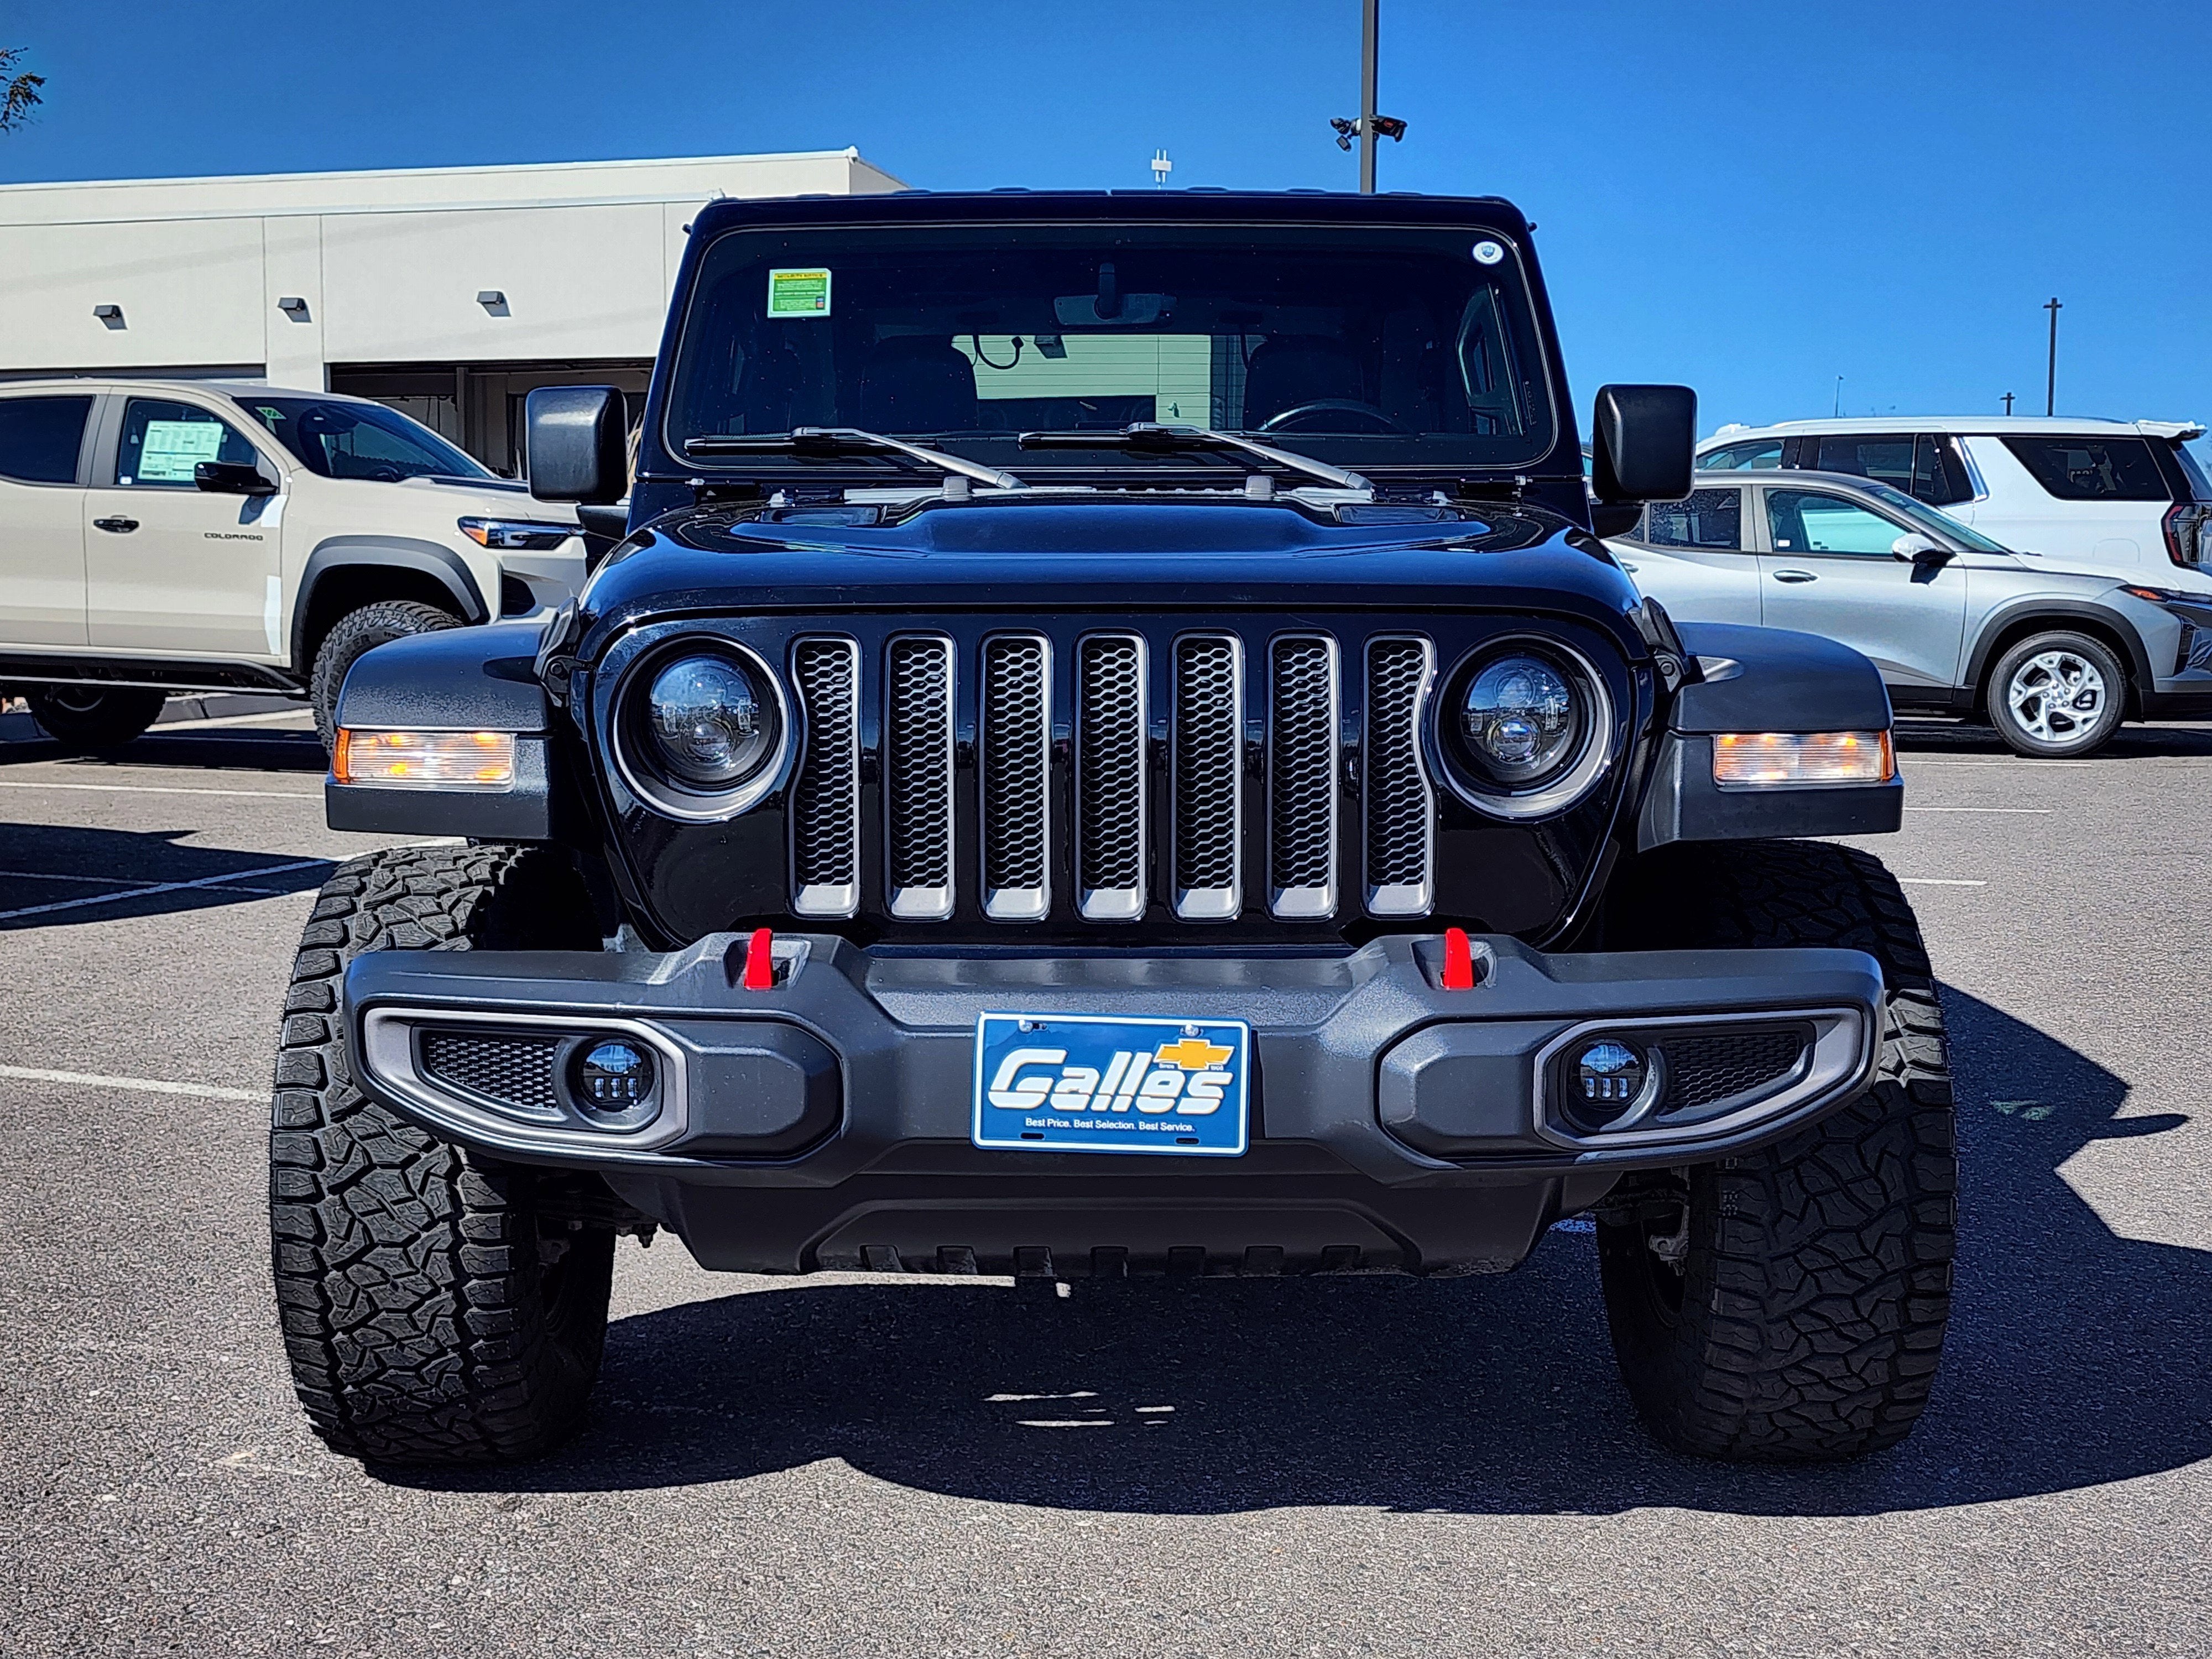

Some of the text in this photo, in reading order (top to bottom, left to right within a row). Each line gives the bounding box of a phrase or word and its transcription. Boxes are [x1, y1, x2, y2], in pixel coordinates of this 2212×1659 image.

[204, 533, 263, 541] COLORADO
[988, 1047, 1234, 1115] Galles
[1025, 1117, 1196, 1131] Best Price. Best Selection. Best Service.
